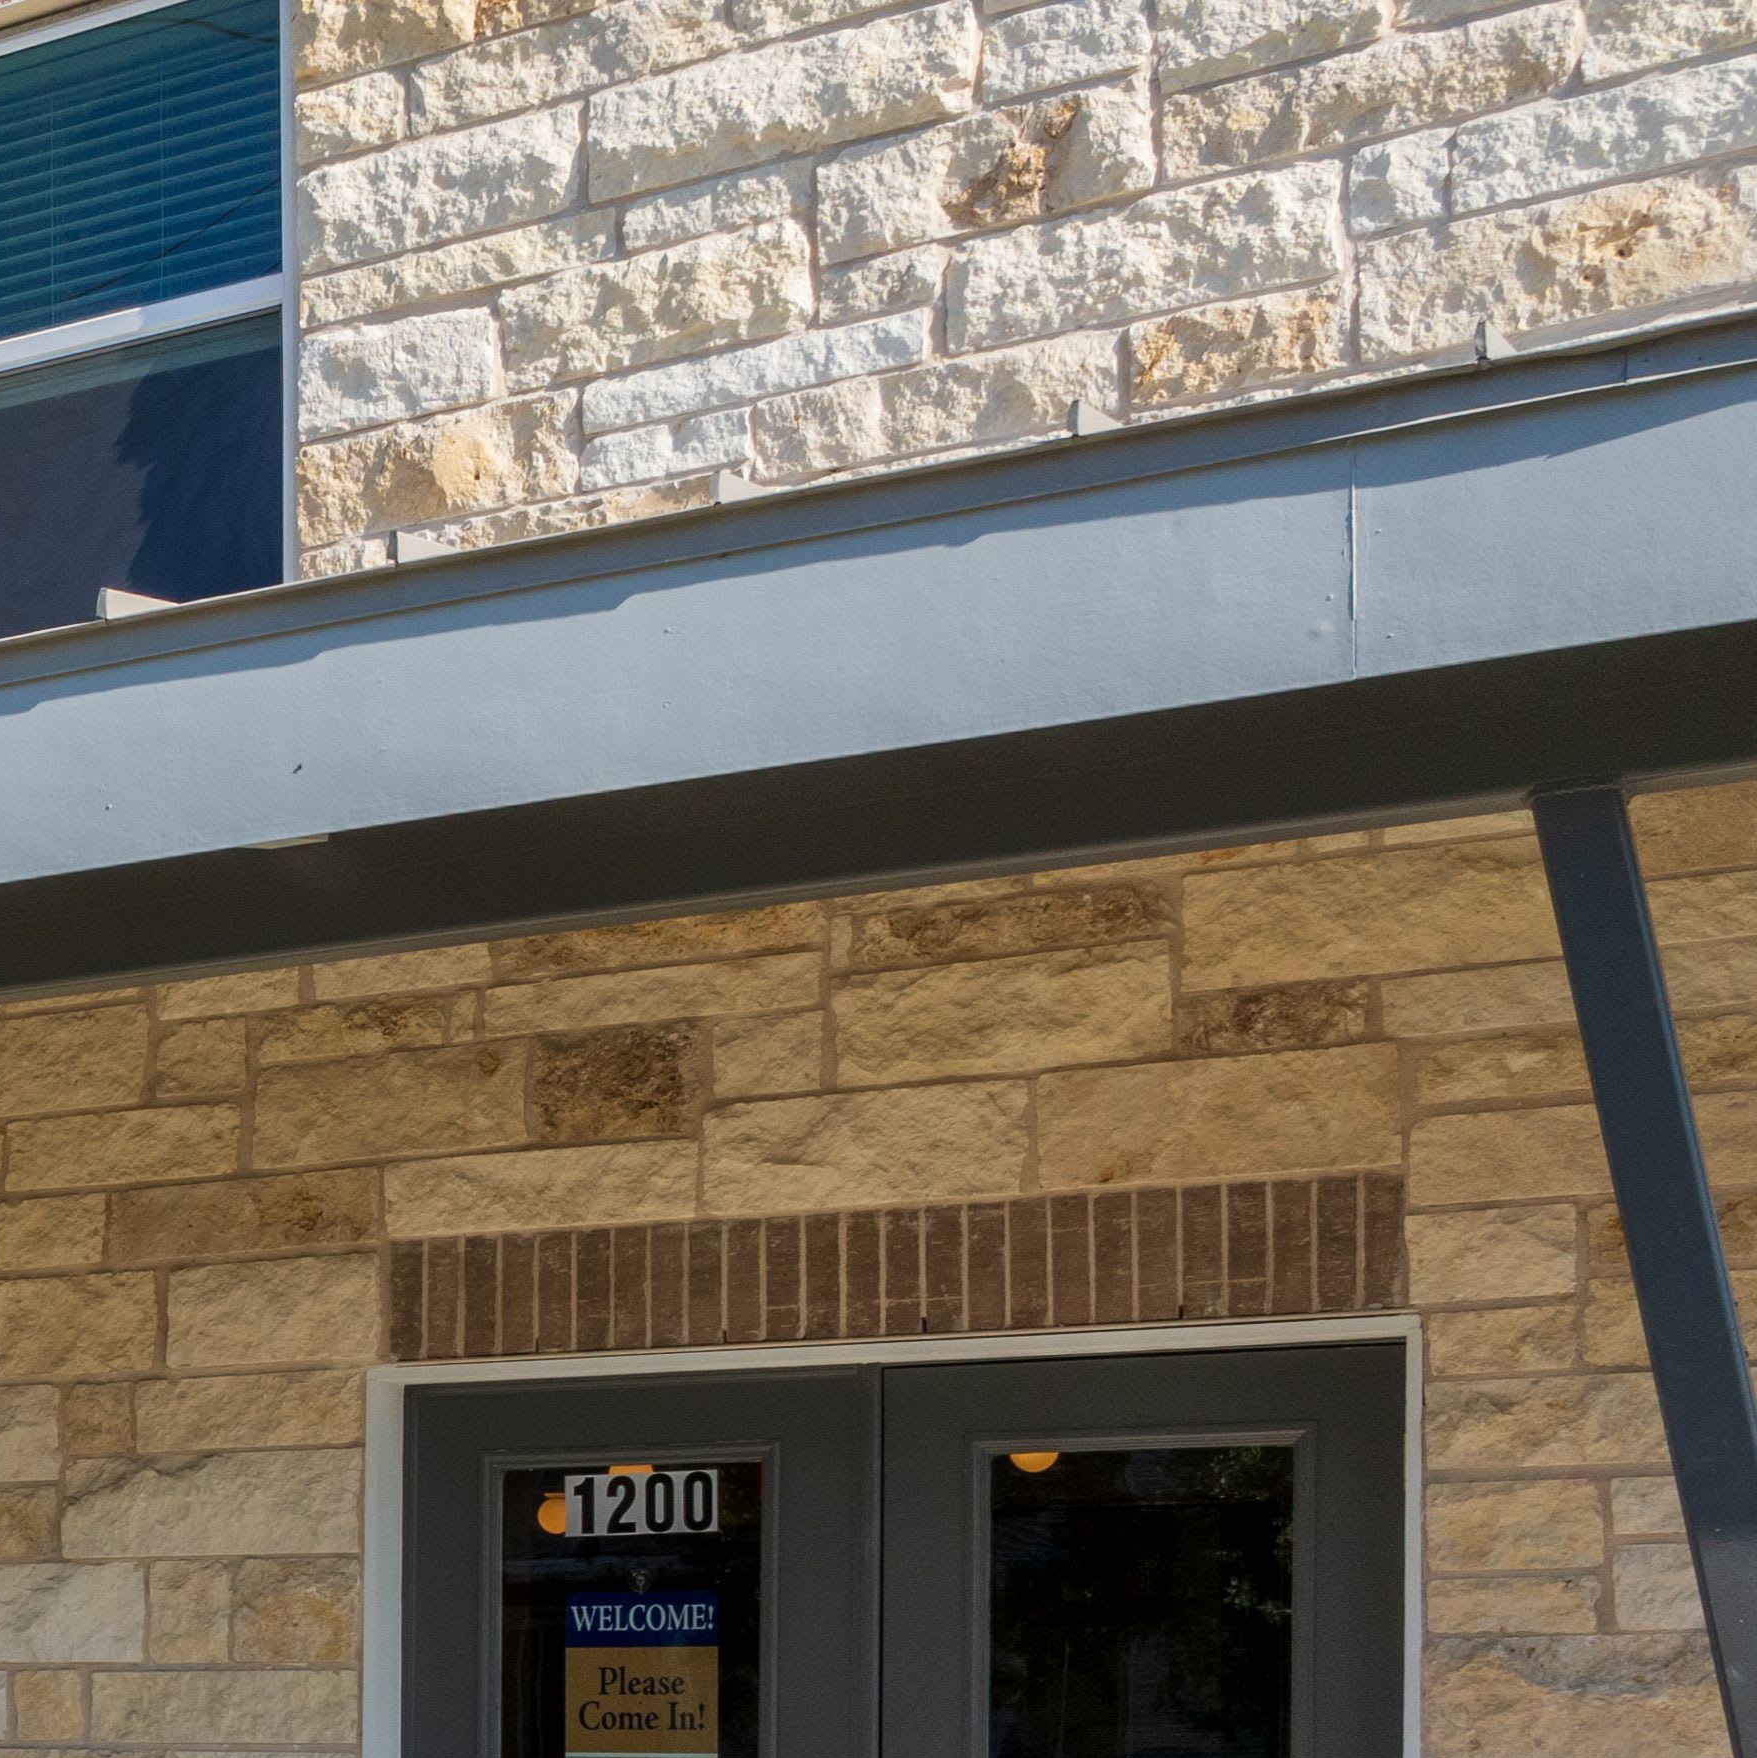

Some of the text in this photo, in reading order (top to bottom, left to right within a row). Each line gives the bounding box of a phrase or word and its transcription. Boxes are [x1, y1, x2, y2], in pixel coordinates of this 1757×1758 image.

[573, 1470, 714, 1534] 1200
[571, 1603, 715, 1633] WELCOME!
[598, 1666, 685, 1696] Please
[578, 1701, 706, 1731] Come In!
